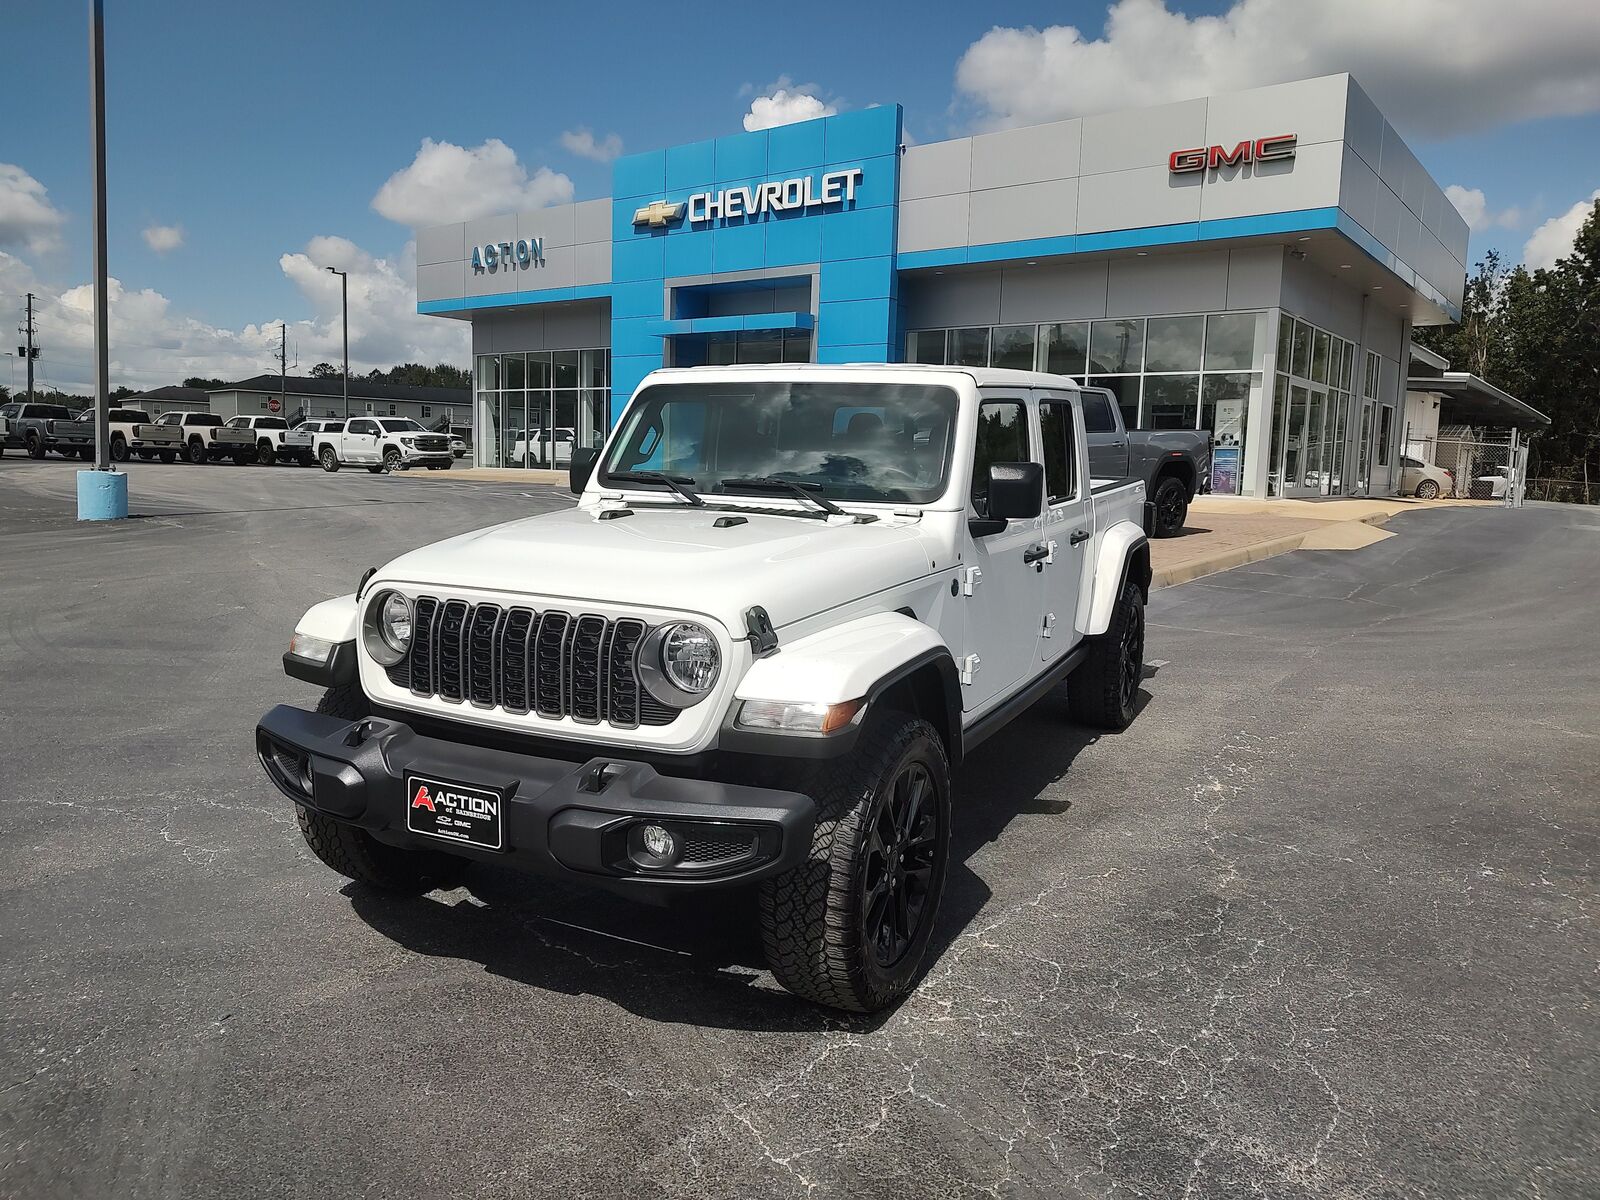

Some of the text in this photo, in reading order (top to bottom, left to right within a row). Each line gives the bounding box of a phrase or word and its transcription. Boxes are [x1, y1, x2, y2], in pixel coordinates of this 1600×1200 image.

[1169, 134, 1297, 173] GMC
[688, 168, 862, 223] CHEVROLET
[471, 237, 543, 269] ACTION
[434, 791, 497, 815] ACTION
[454, 820, 471, 829] GMC
